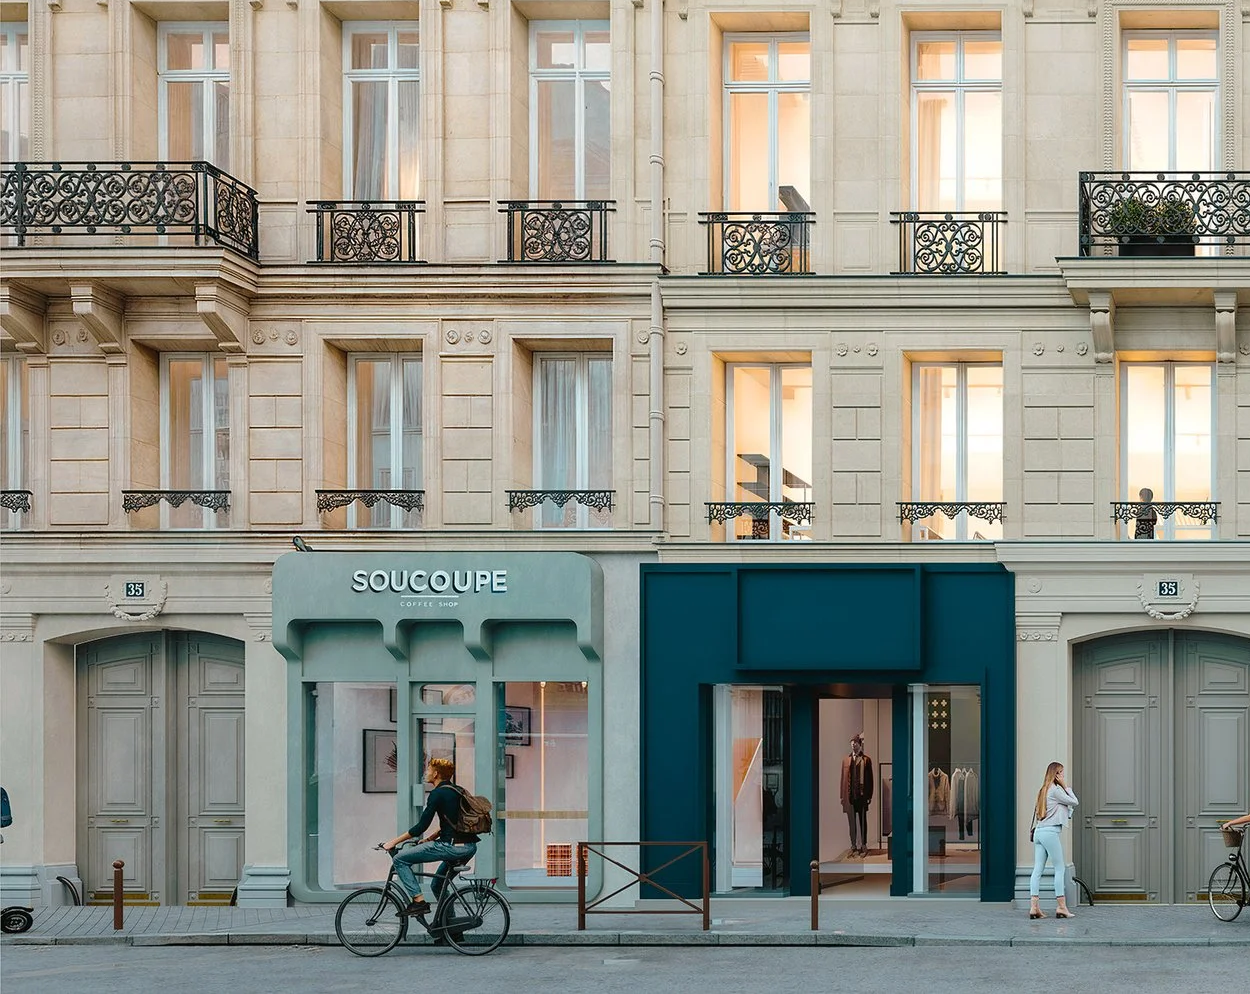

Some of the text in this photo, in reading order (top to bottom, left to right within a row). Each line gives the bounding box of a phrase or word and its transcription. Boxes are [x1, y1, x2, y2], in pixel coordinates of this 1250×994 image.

[351, 569, 507, 593] SOUCOUPE
[127, 583, 143, 596] 35
[1160, 582, 1176, 595] 35
